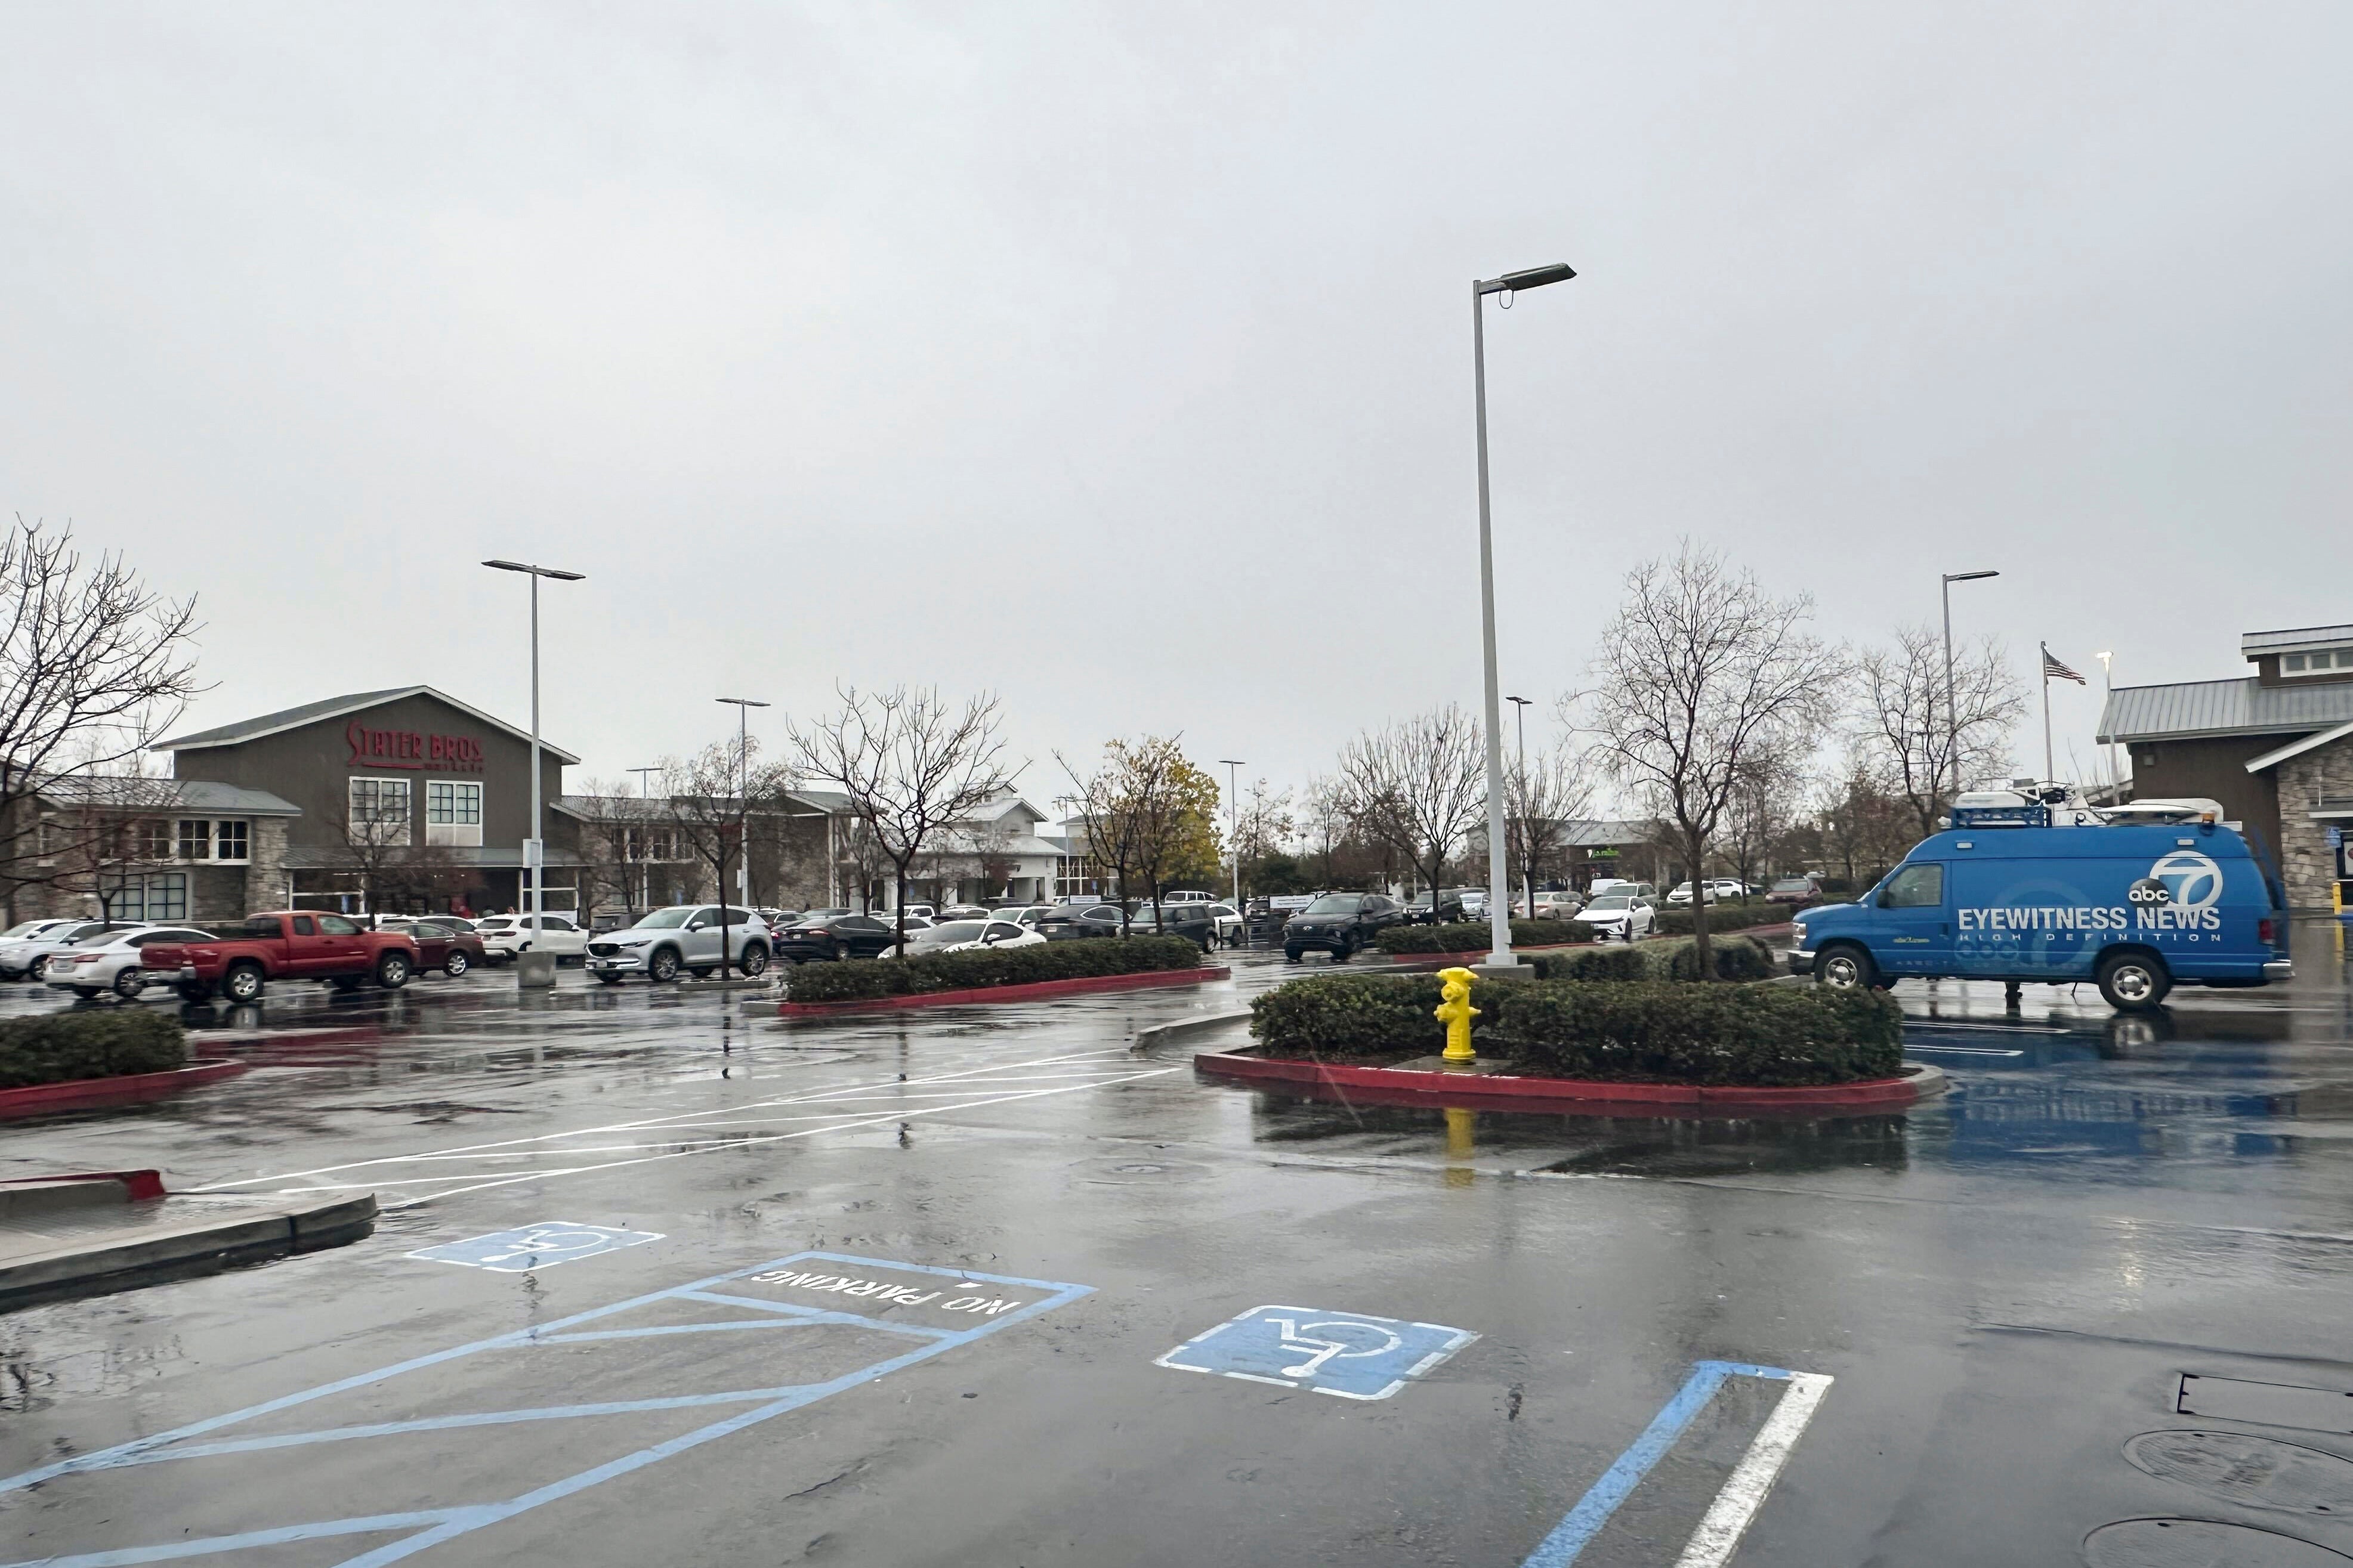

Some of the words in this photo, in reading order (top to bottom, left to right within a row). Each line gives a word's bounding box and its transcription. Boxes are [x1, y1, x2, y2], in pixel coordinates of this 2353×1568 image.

[347, 720, 422, 766] STATER
[2128, 886, 2169, 902] abc
[1958, 907, 2127, 930] EYEWITNESS
[2136, 907, 2221, 930] NEWS
[1959, 933, 2021, 941] HIGH
[2046, 933, 2221, 942] DEFINITION
[751, 1270, 946, 1305] PARKING
[941, 1295, 1021, 1315] NO
